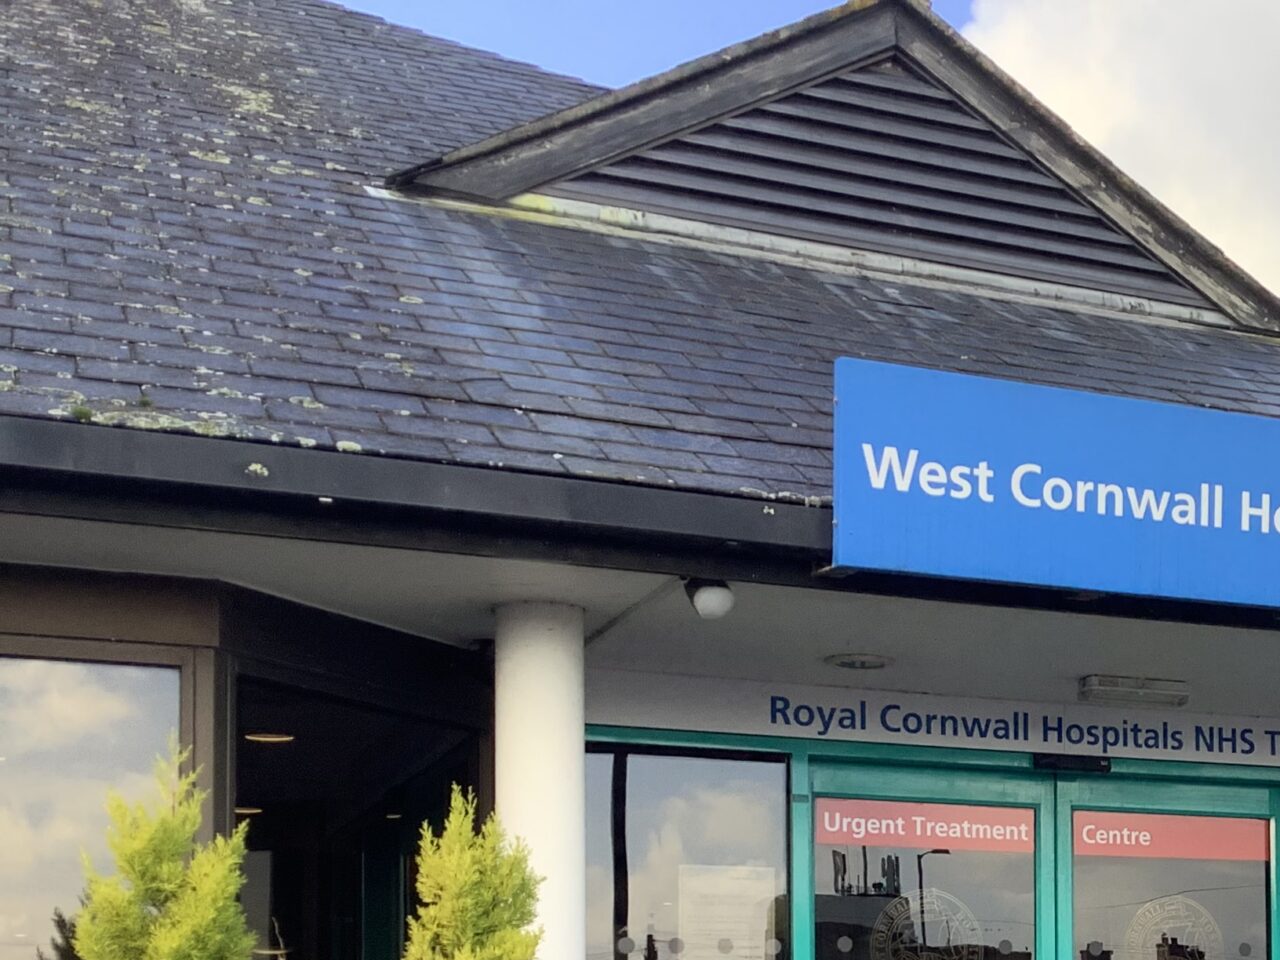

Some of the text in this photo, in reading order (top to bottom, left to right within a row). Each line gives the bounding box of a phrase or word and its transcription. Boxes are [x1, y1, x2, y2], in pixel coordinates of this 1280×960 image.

[861, 443, 994, 503] West
[1011, 463, 1223, 528] Cornwall
[770, 695, 867, 735] Royal
[880, 704, 1029, 741] Cornwall
[1042, 715, 1183, 753] Hospitals
[1195, 725, 1255, 754] NHS
[823, 811, 1029, 842] Urgent Treatment
[1082, 824, 1151, 846] Centre
